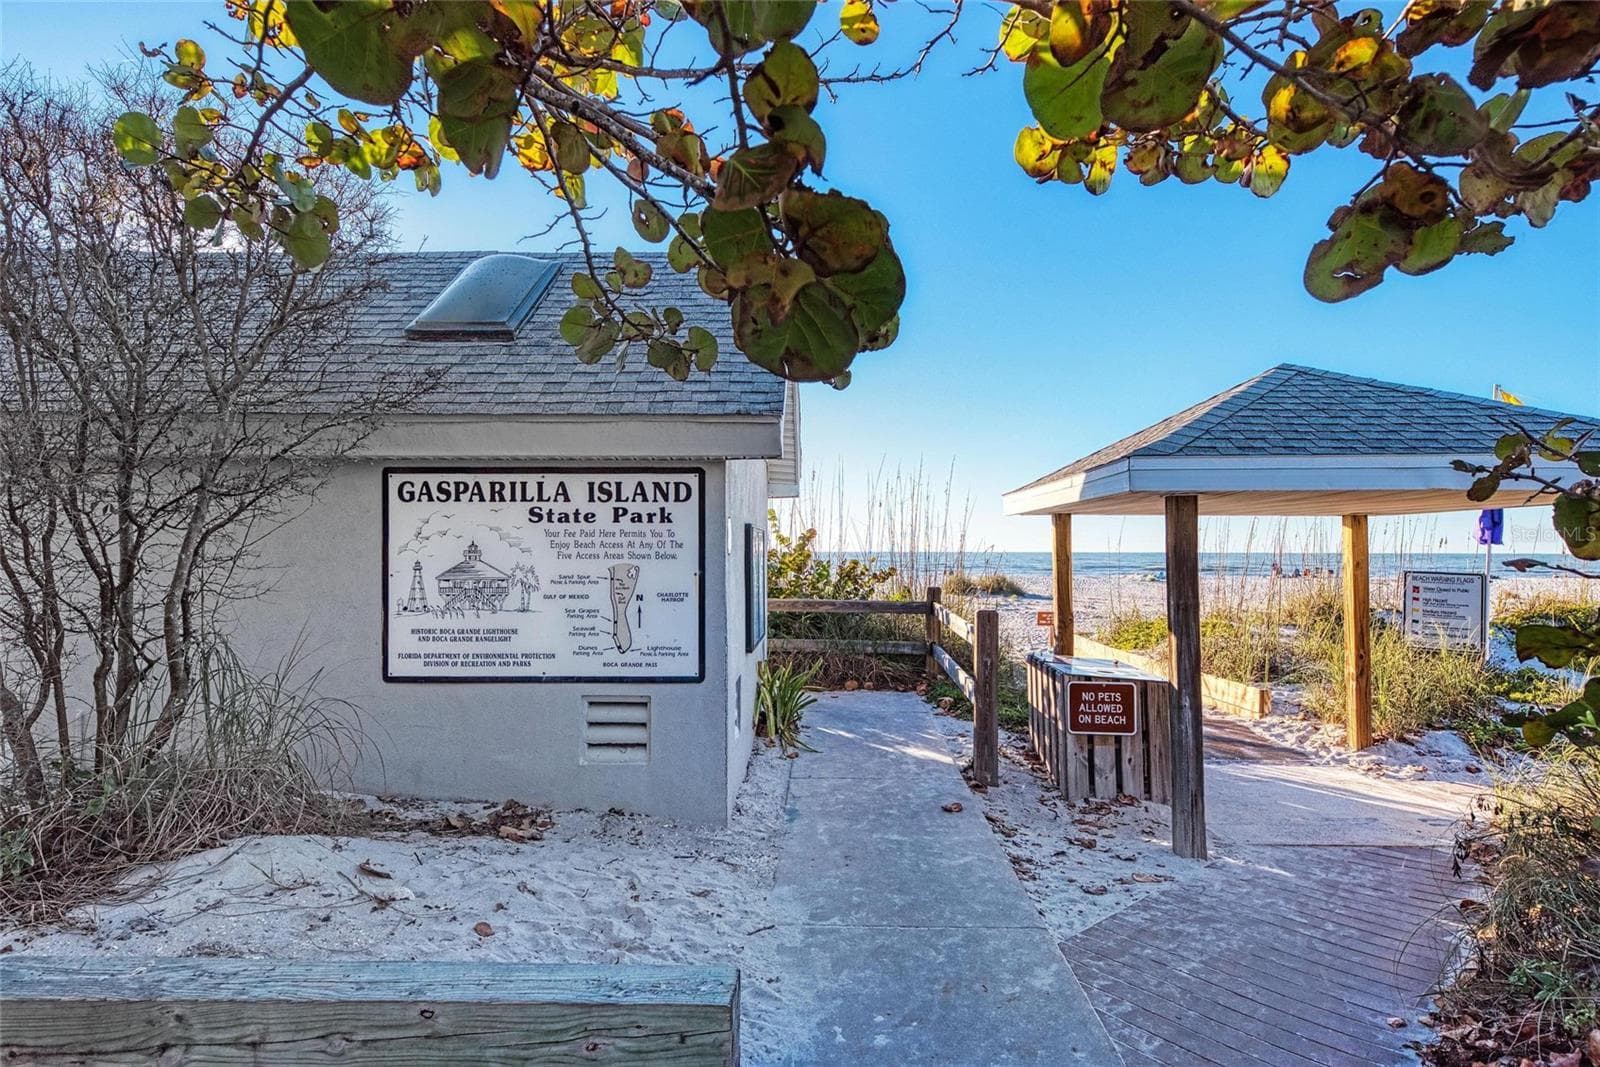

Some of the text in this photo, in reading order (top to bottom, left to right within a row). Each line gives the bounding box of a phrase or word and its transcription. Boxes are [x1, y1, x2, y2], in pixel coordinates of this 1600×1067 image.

[397, 480, 692, 502] GASPARILLA ISLAND
[528, 506, 674, 524] State Park
[544, 529, 675, 538] Your Fee Paid Here Permits You To
[550, 540, 684, 550] Enjoy Beach Access At Any Of The
[557, 551, 572, 560] Five
[576, 551, 600, 560] Access
[604, 551, 624, 560] Areas
[628, 551, 651, 560] Shown
[1082, 692, 1122, 702] NO PETS
[1079, 704, 1123, 713] ALLOWED
[1078, 714, 1126, 725] ON BEACH
